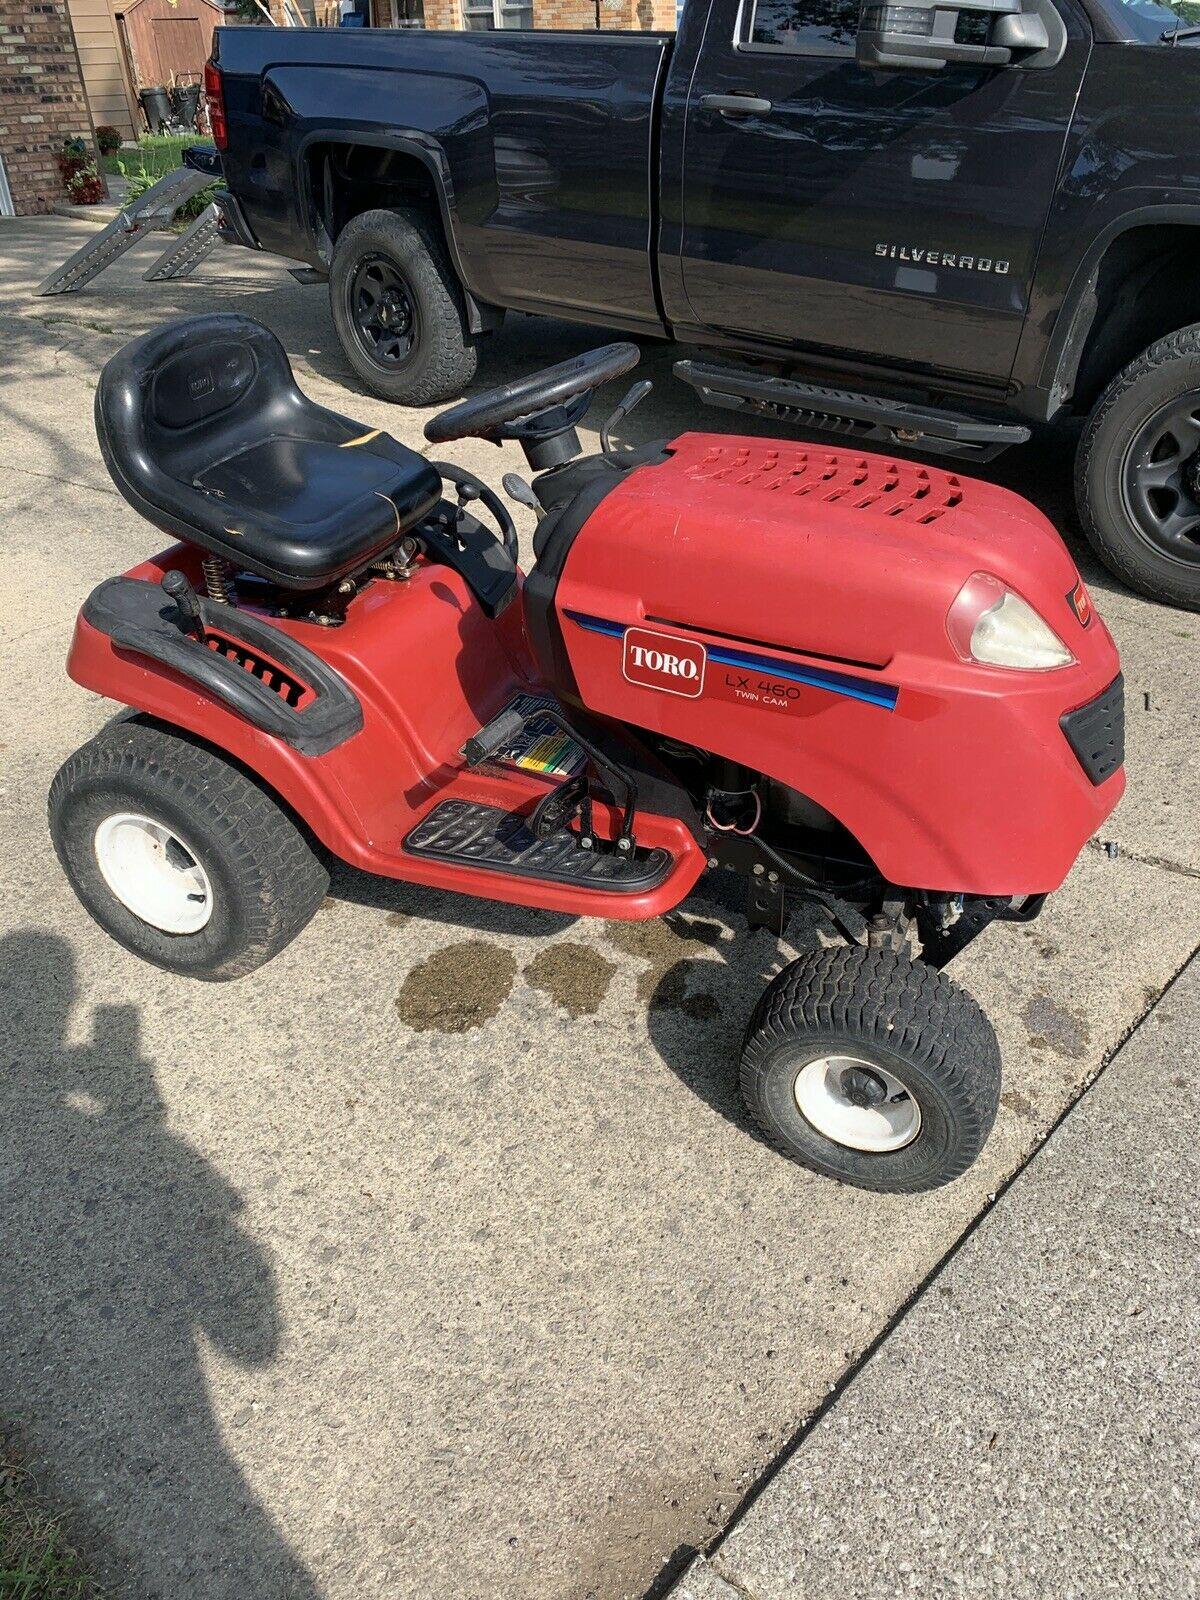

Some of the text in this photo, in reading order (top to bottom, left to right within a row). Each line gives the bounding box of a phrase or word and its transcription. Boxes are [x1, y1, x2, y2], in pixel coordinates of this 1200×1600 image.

[875, 243, 1010, 274] SILVERADO
[630, 645, 697, 679] TORO
[725, 673, 801, 700] LX 460
[734, 689, 788, 708] TWIN CAM
